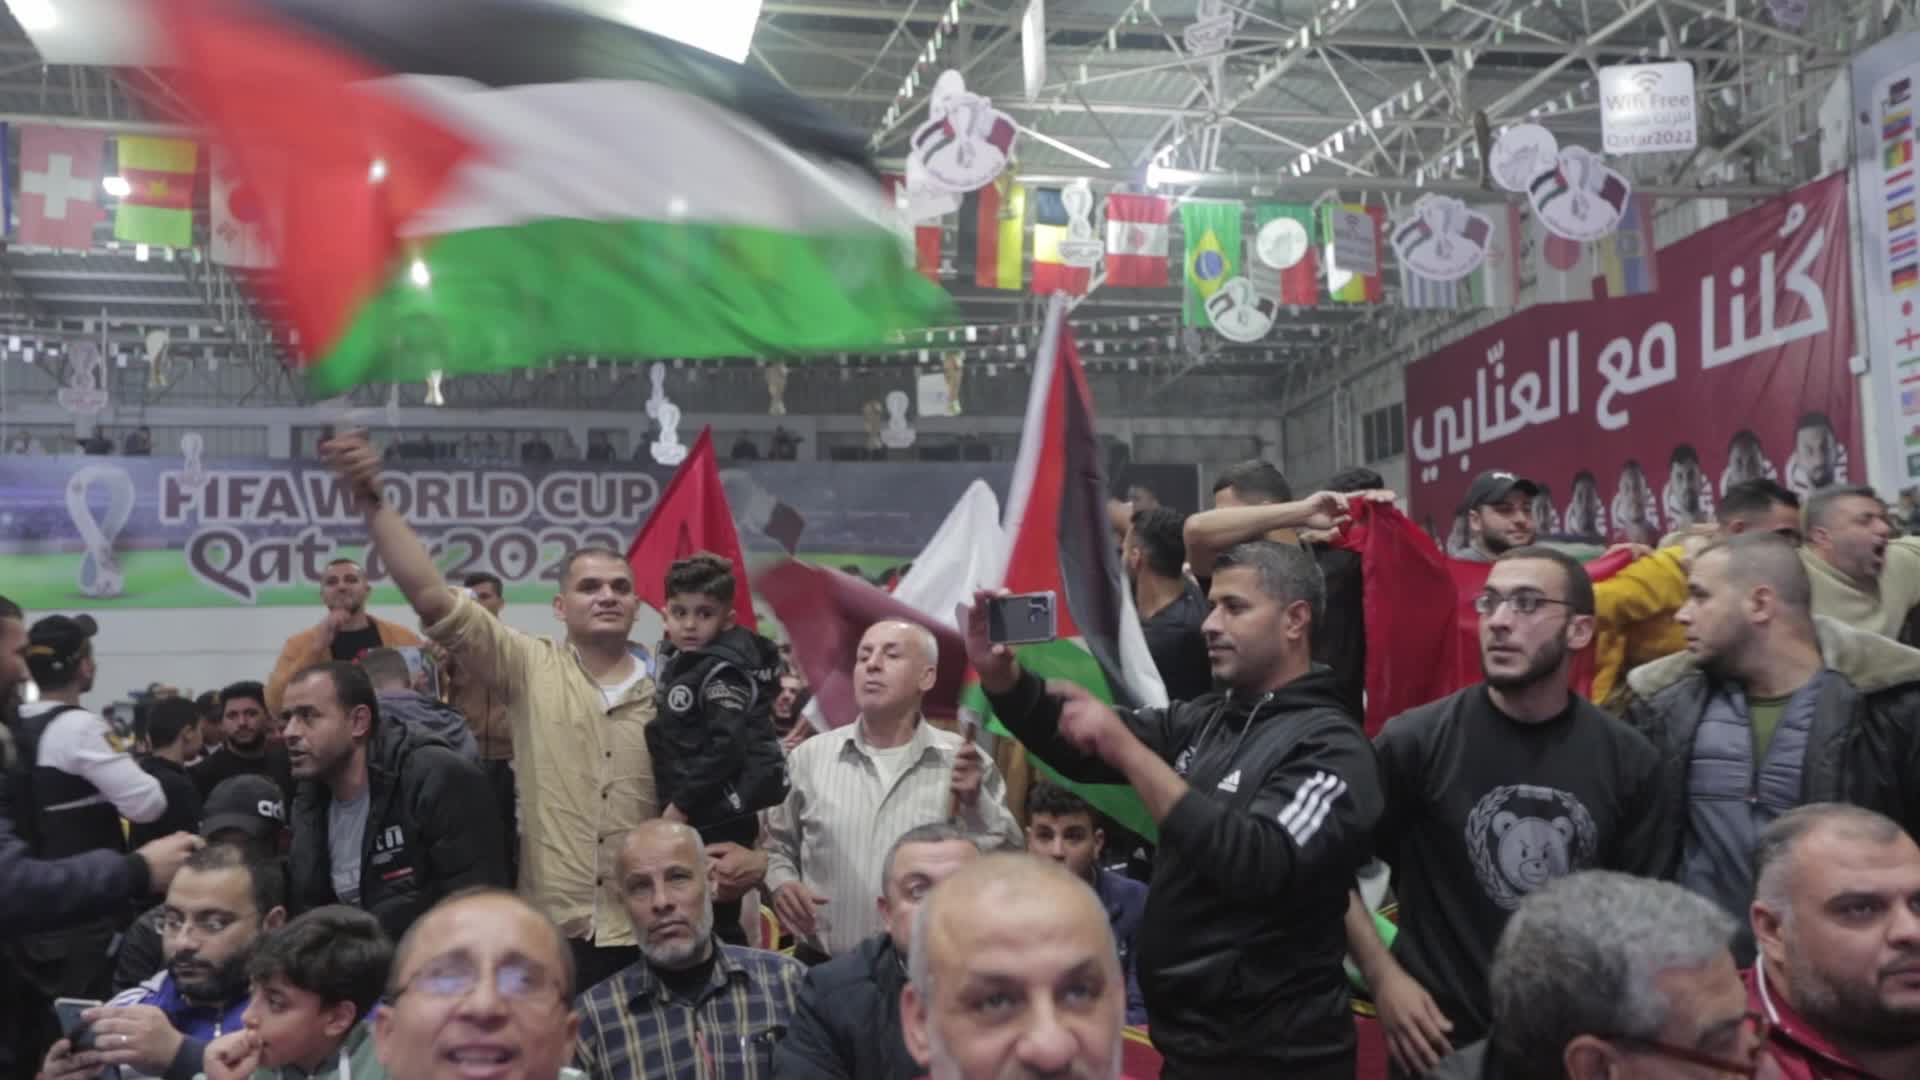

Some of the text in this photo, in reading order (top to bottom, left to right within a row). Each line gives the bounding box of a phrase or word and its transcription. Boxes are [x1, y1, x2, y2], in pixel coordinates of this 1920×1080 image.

[1649, 93, 1690, 109] Free
[1597, 320, 1677, 430] مع
[162, 473, 655, 521] FIFA WORLD CUP
